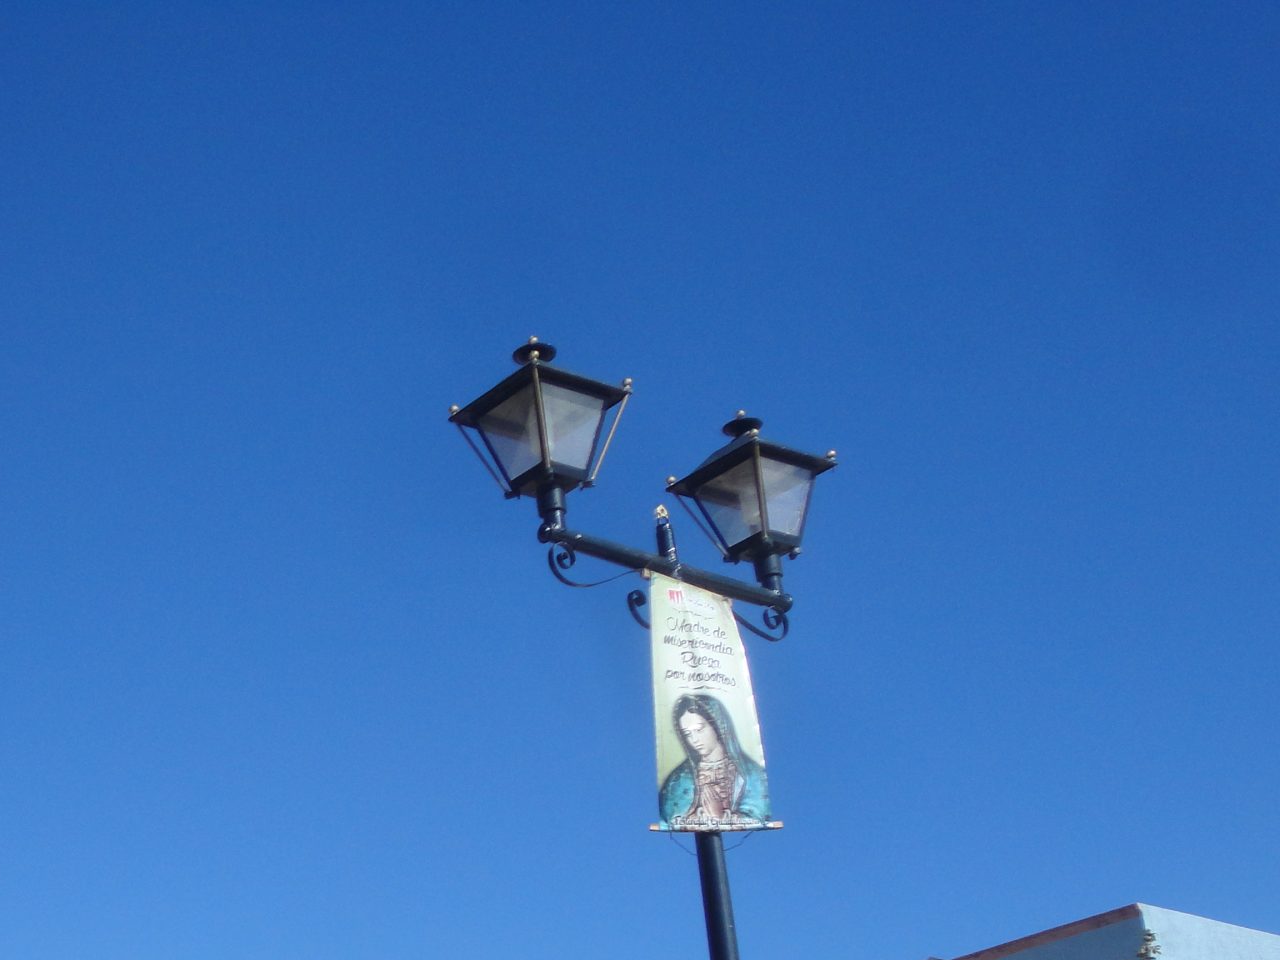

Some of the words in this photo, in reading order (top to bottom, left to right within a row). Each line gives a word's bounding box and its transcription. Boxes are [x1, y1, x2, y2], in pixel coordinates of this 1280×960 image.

[666, 616, 711, 637] Madre
[712, 626, 728, 640] de
[680, 651, 721, 669] Ruega
[664, 669, 686, 682] por
[687, 671, 736, 687] nosotros
